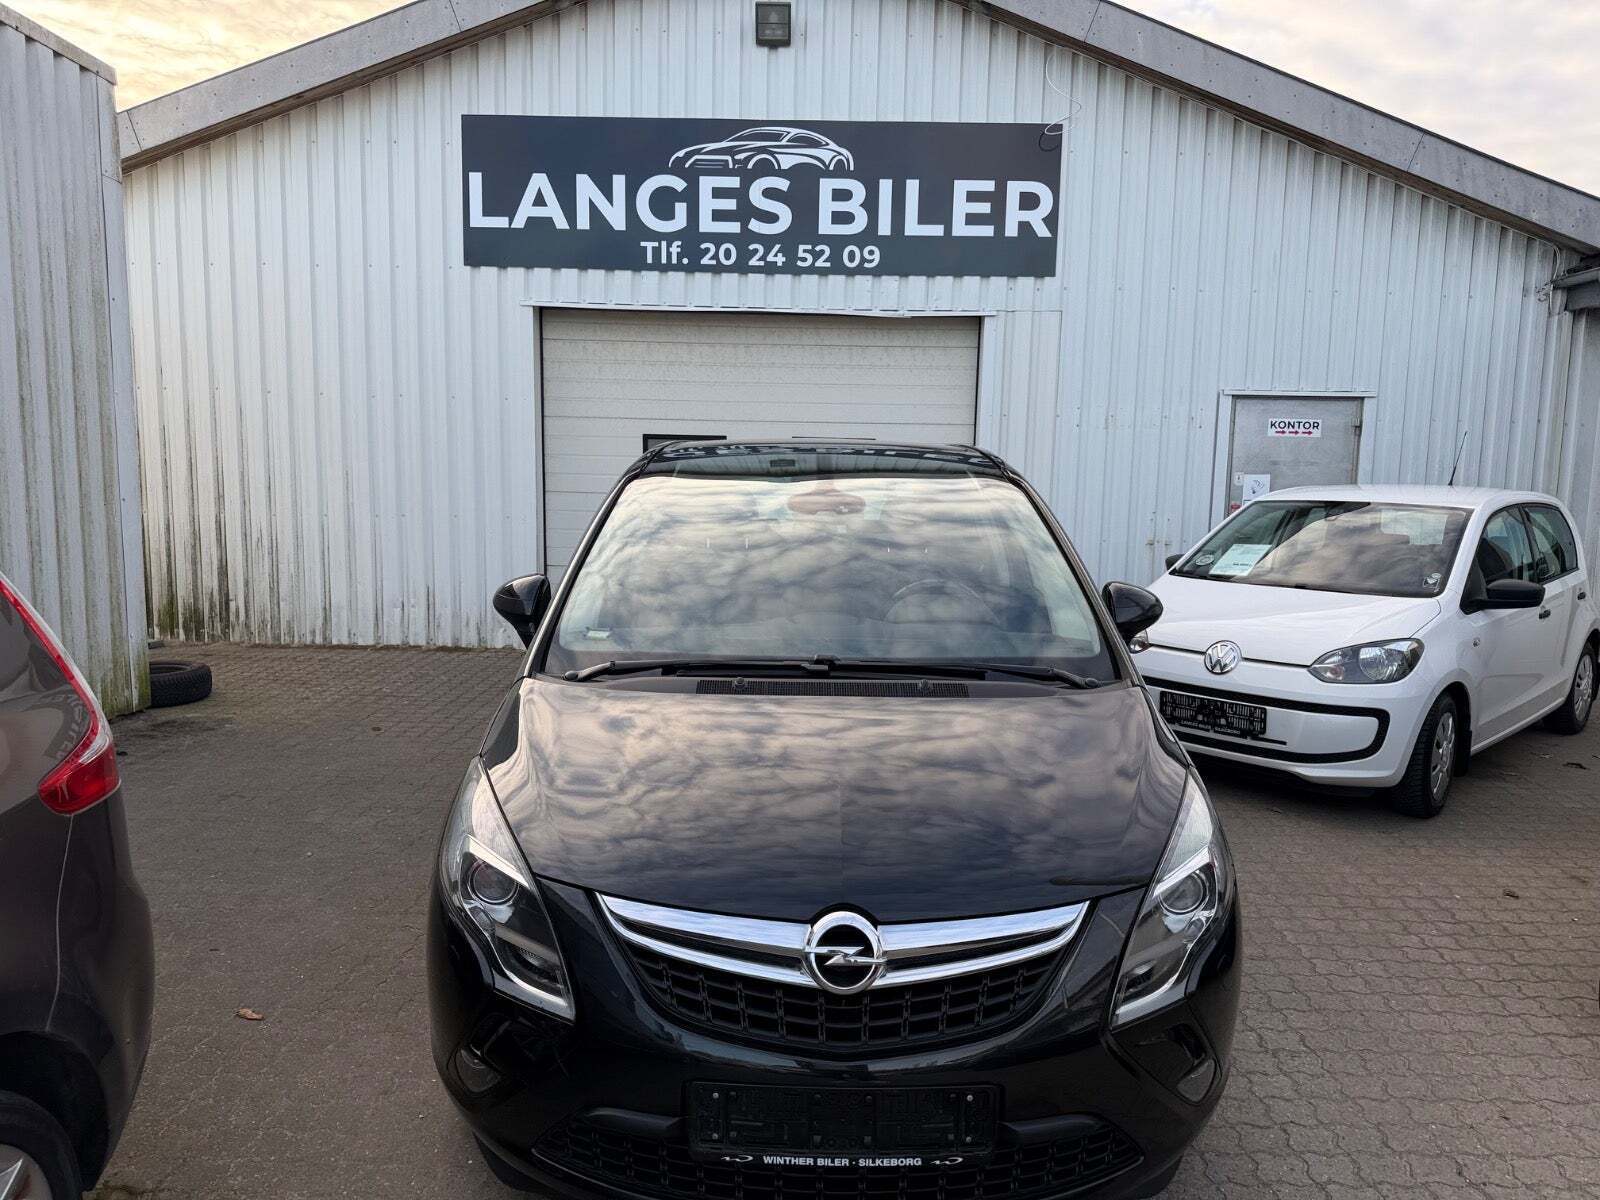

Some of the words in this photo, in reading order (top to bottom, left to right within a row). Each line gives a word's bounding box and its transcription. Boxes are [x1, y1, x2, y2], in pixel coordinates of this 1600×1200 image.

[468, 171, 793, 235] LANGES
[818, 177, 1054, 238] BILER
[640, 240, 689, 267] Tlf.
[700, 242, 737, 266] 20
[748, 243, 786, 267] 24
[797, 244, 831, 268] 52
[842, 245, 881, 269] 09
[1270, 420, 1320, 430] KONTOR
[763, 1155, 814, 1166] WINTHER
[817, 1157, 850, 1167] BILER
[858, 1157, 923, 1167] SILKEBORG
